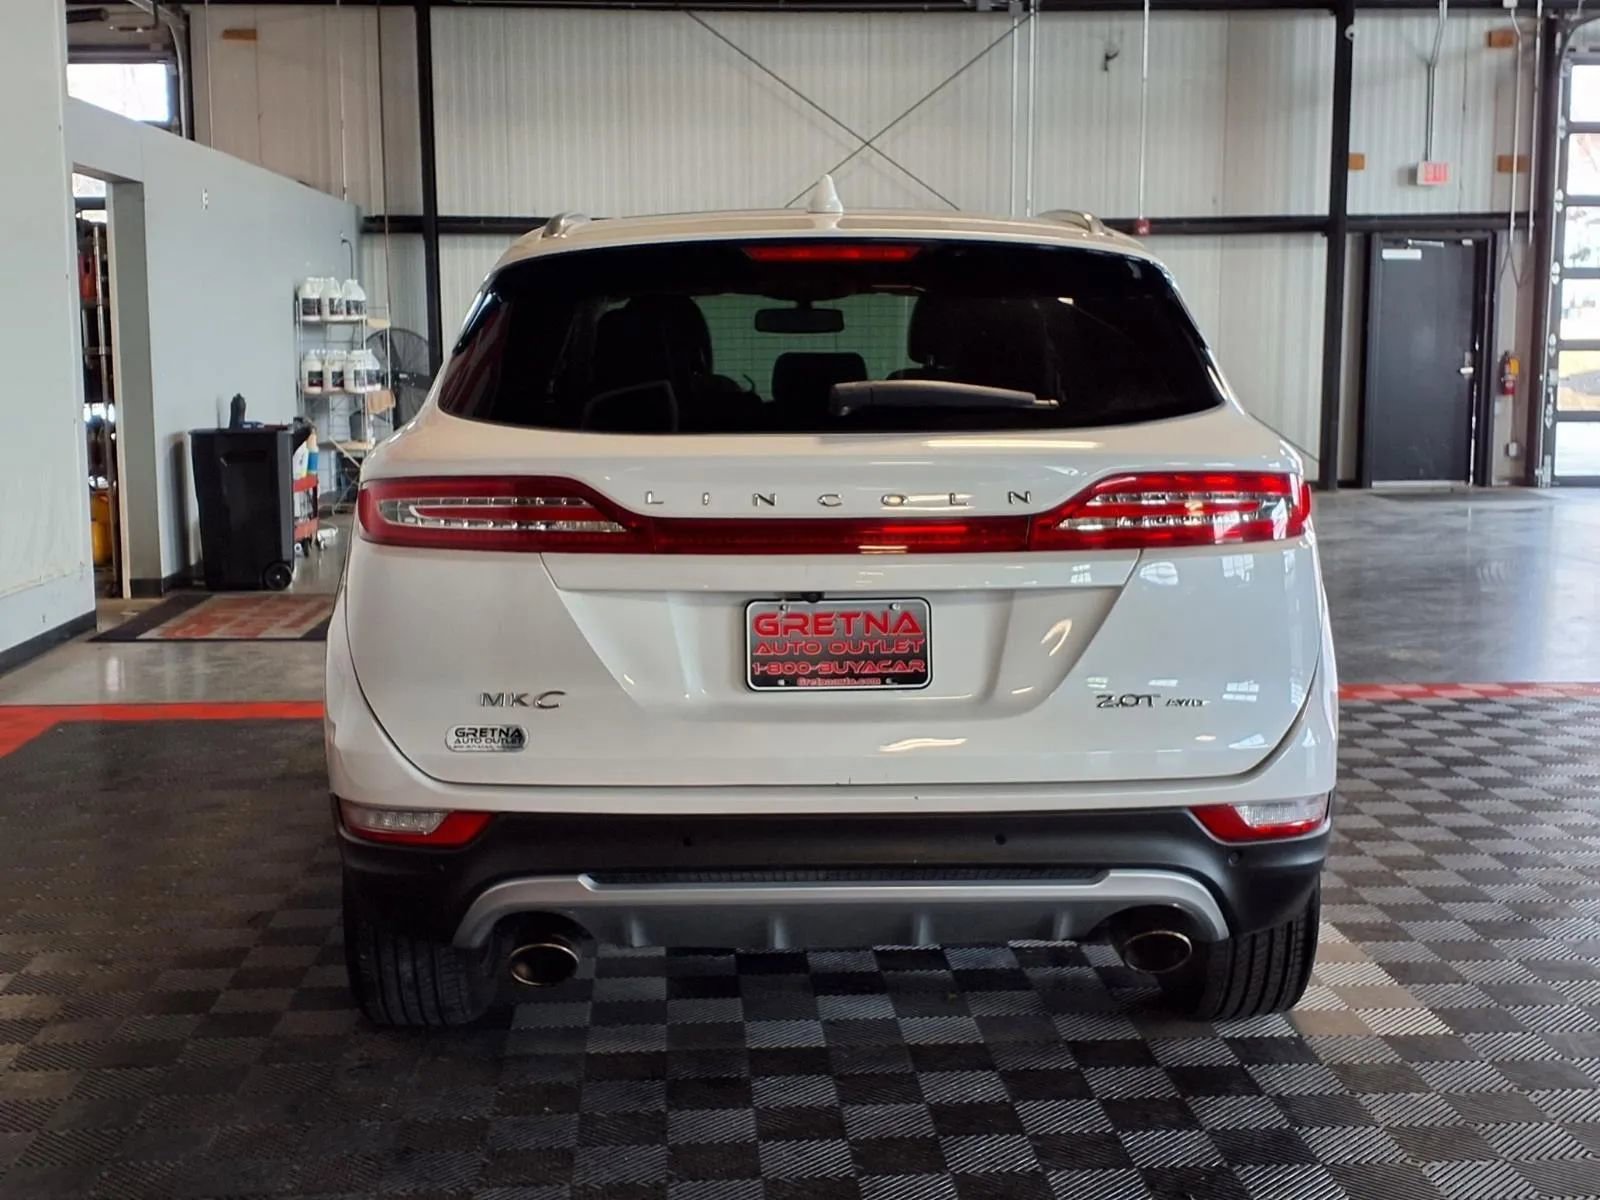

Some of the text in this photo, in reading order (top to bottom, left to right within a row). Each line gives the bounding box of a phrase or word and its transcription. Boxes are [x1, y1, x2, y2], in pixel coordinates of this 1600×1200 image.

[645, 490, 1032, 508] LINCOLN
[753, 611, 924, 637] GRETNA
[753, 638, 926, 656] AUTO OUTLET
[752, 660, 926, 676] 1-800-BUYACAR
[480, 690, 567, 709] MKC
[454, 727, 523, 738] GRETNA
[454, 737, 483, 745] AUTO
